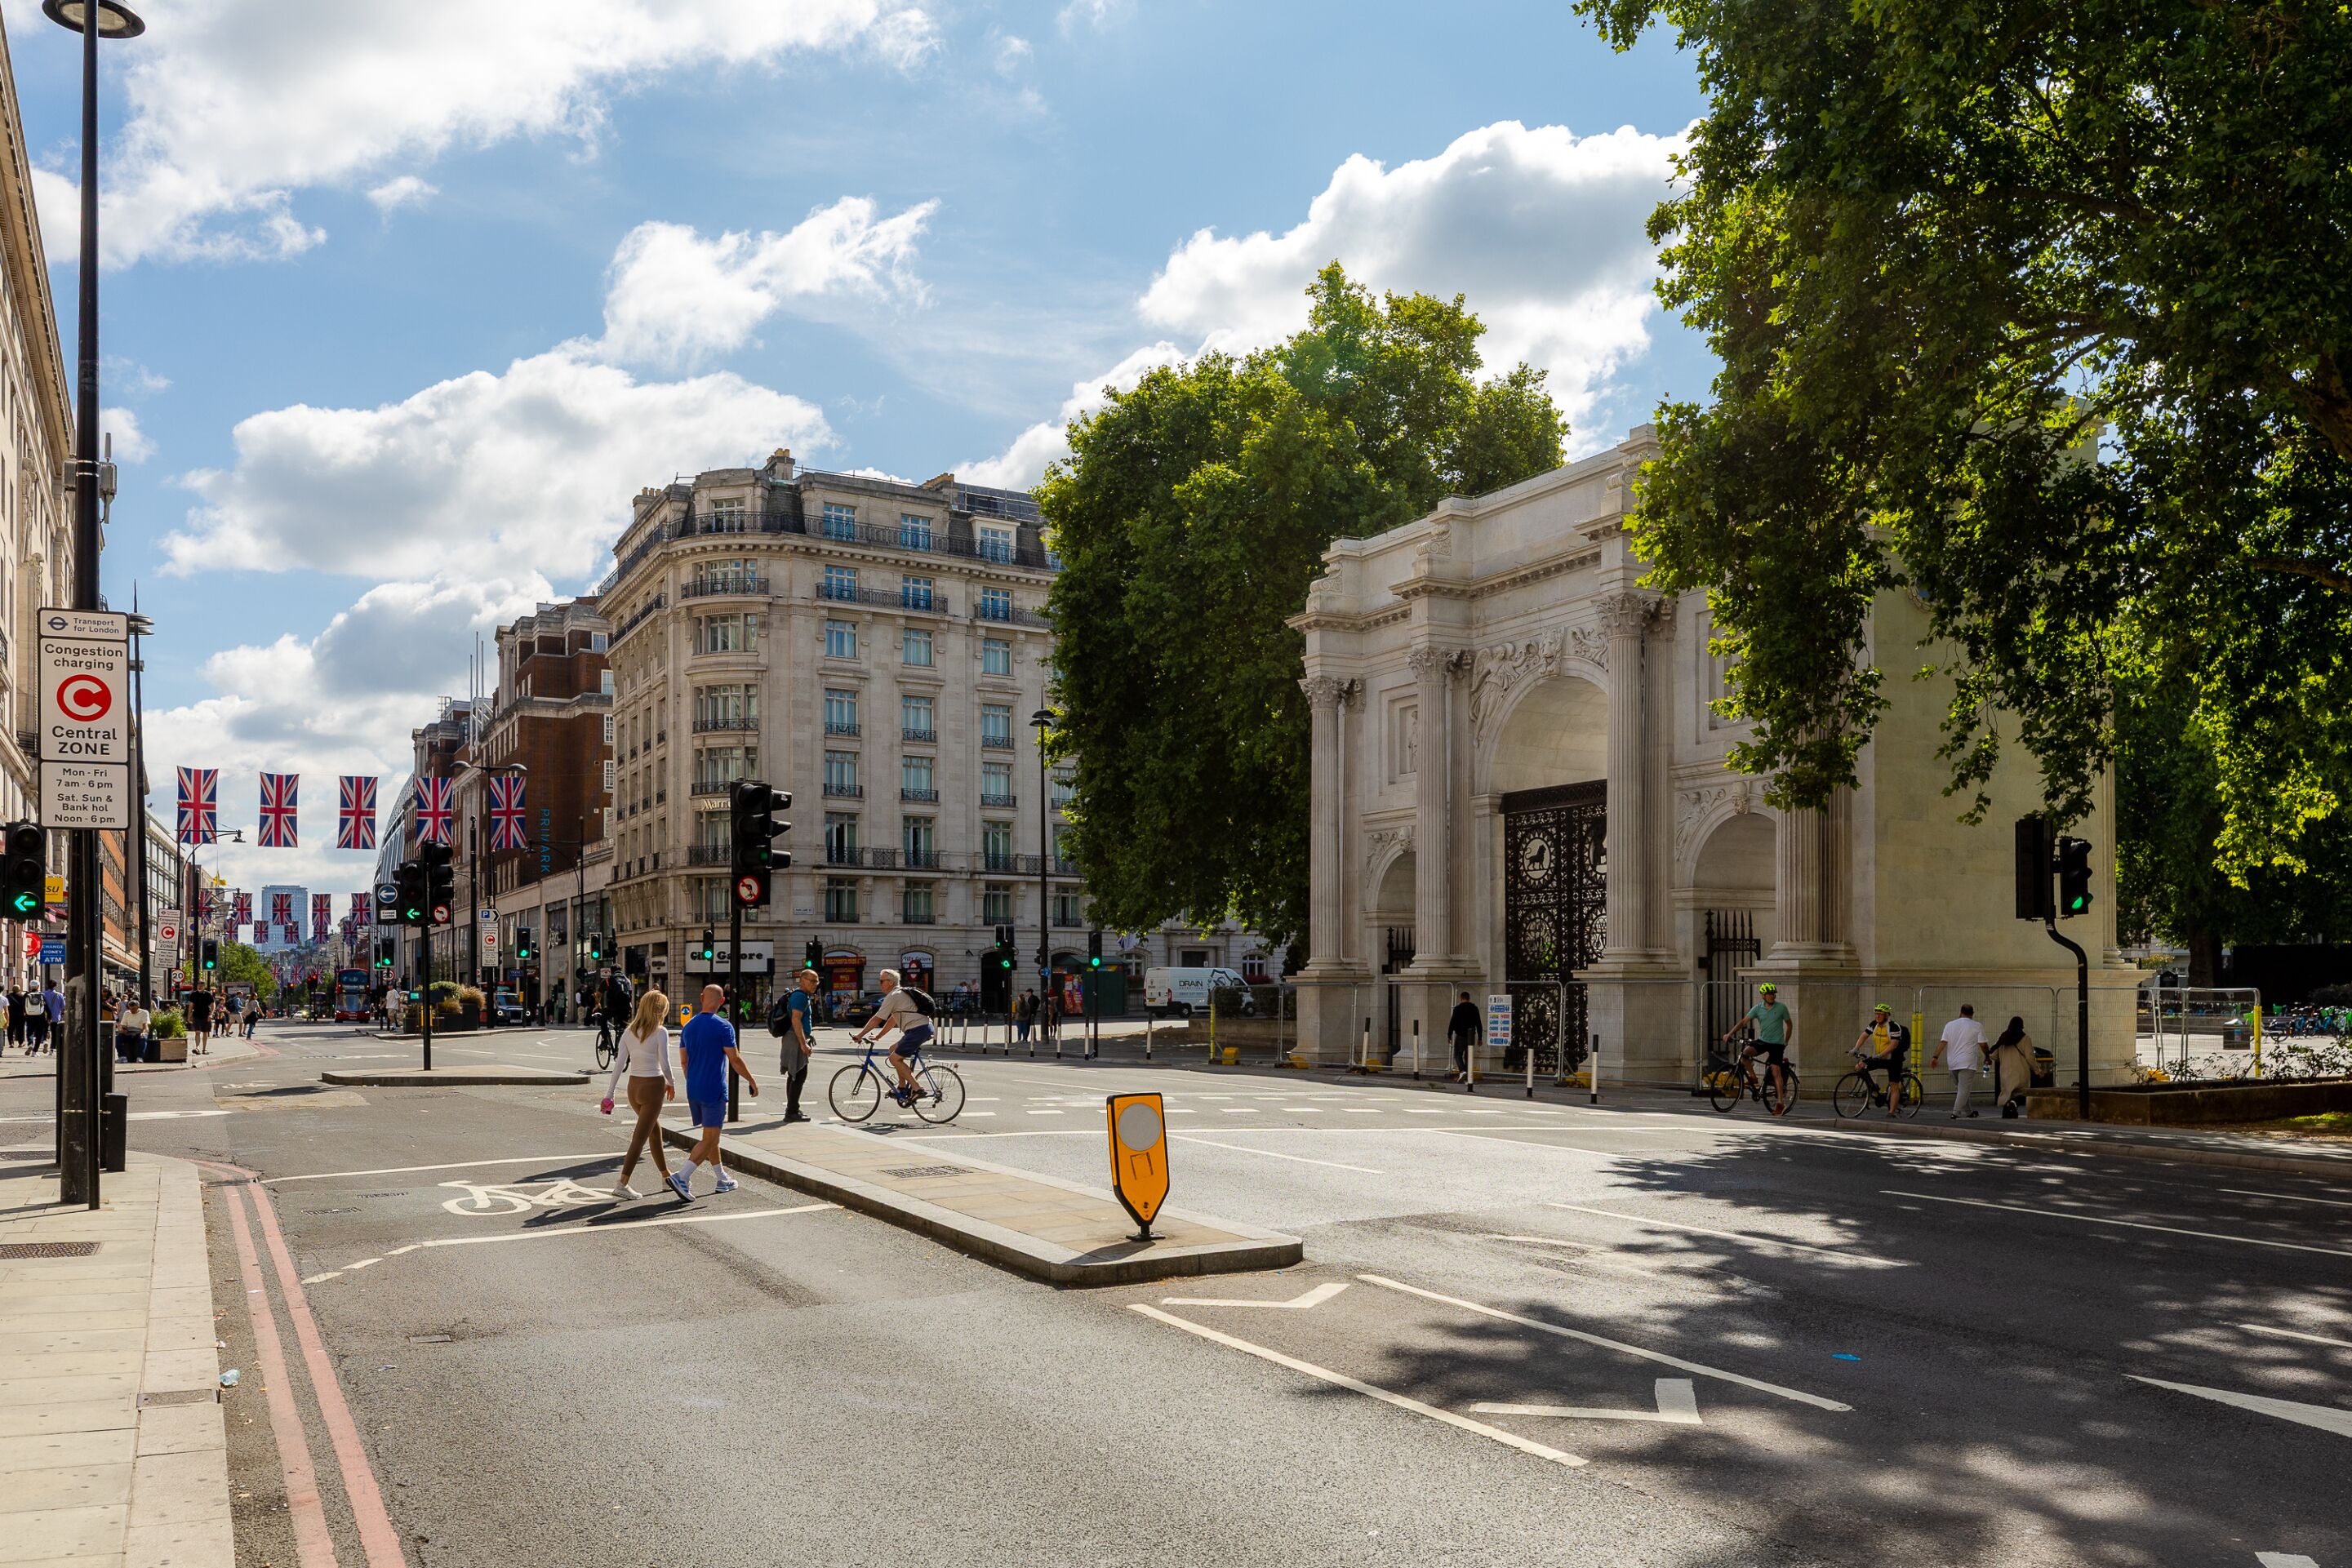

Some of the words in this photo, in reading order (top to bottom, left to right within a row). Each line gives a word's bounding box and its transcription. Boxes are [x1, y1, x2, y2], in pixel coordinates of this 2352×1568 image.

[73, 618, 114, 626] Transport
[45, 644, 123, 657] Congestion
[54, 658, 113, 671] charging
[52, 726, 117, 740] Central
[59, 742, 110, 755] ZONE
[63, 768, 85, 776] Mon
[94, 769, 108, 777] Fri
[56, 779, 62, 787] 7
[57, 793, 78, 802] Sat.
[82, 794, 102, 802] Sun
[62, 803, 88, 811] Bank
[540, 809, 550, 873] PRIMARK
[716, 951, 763, 960] Gaore
